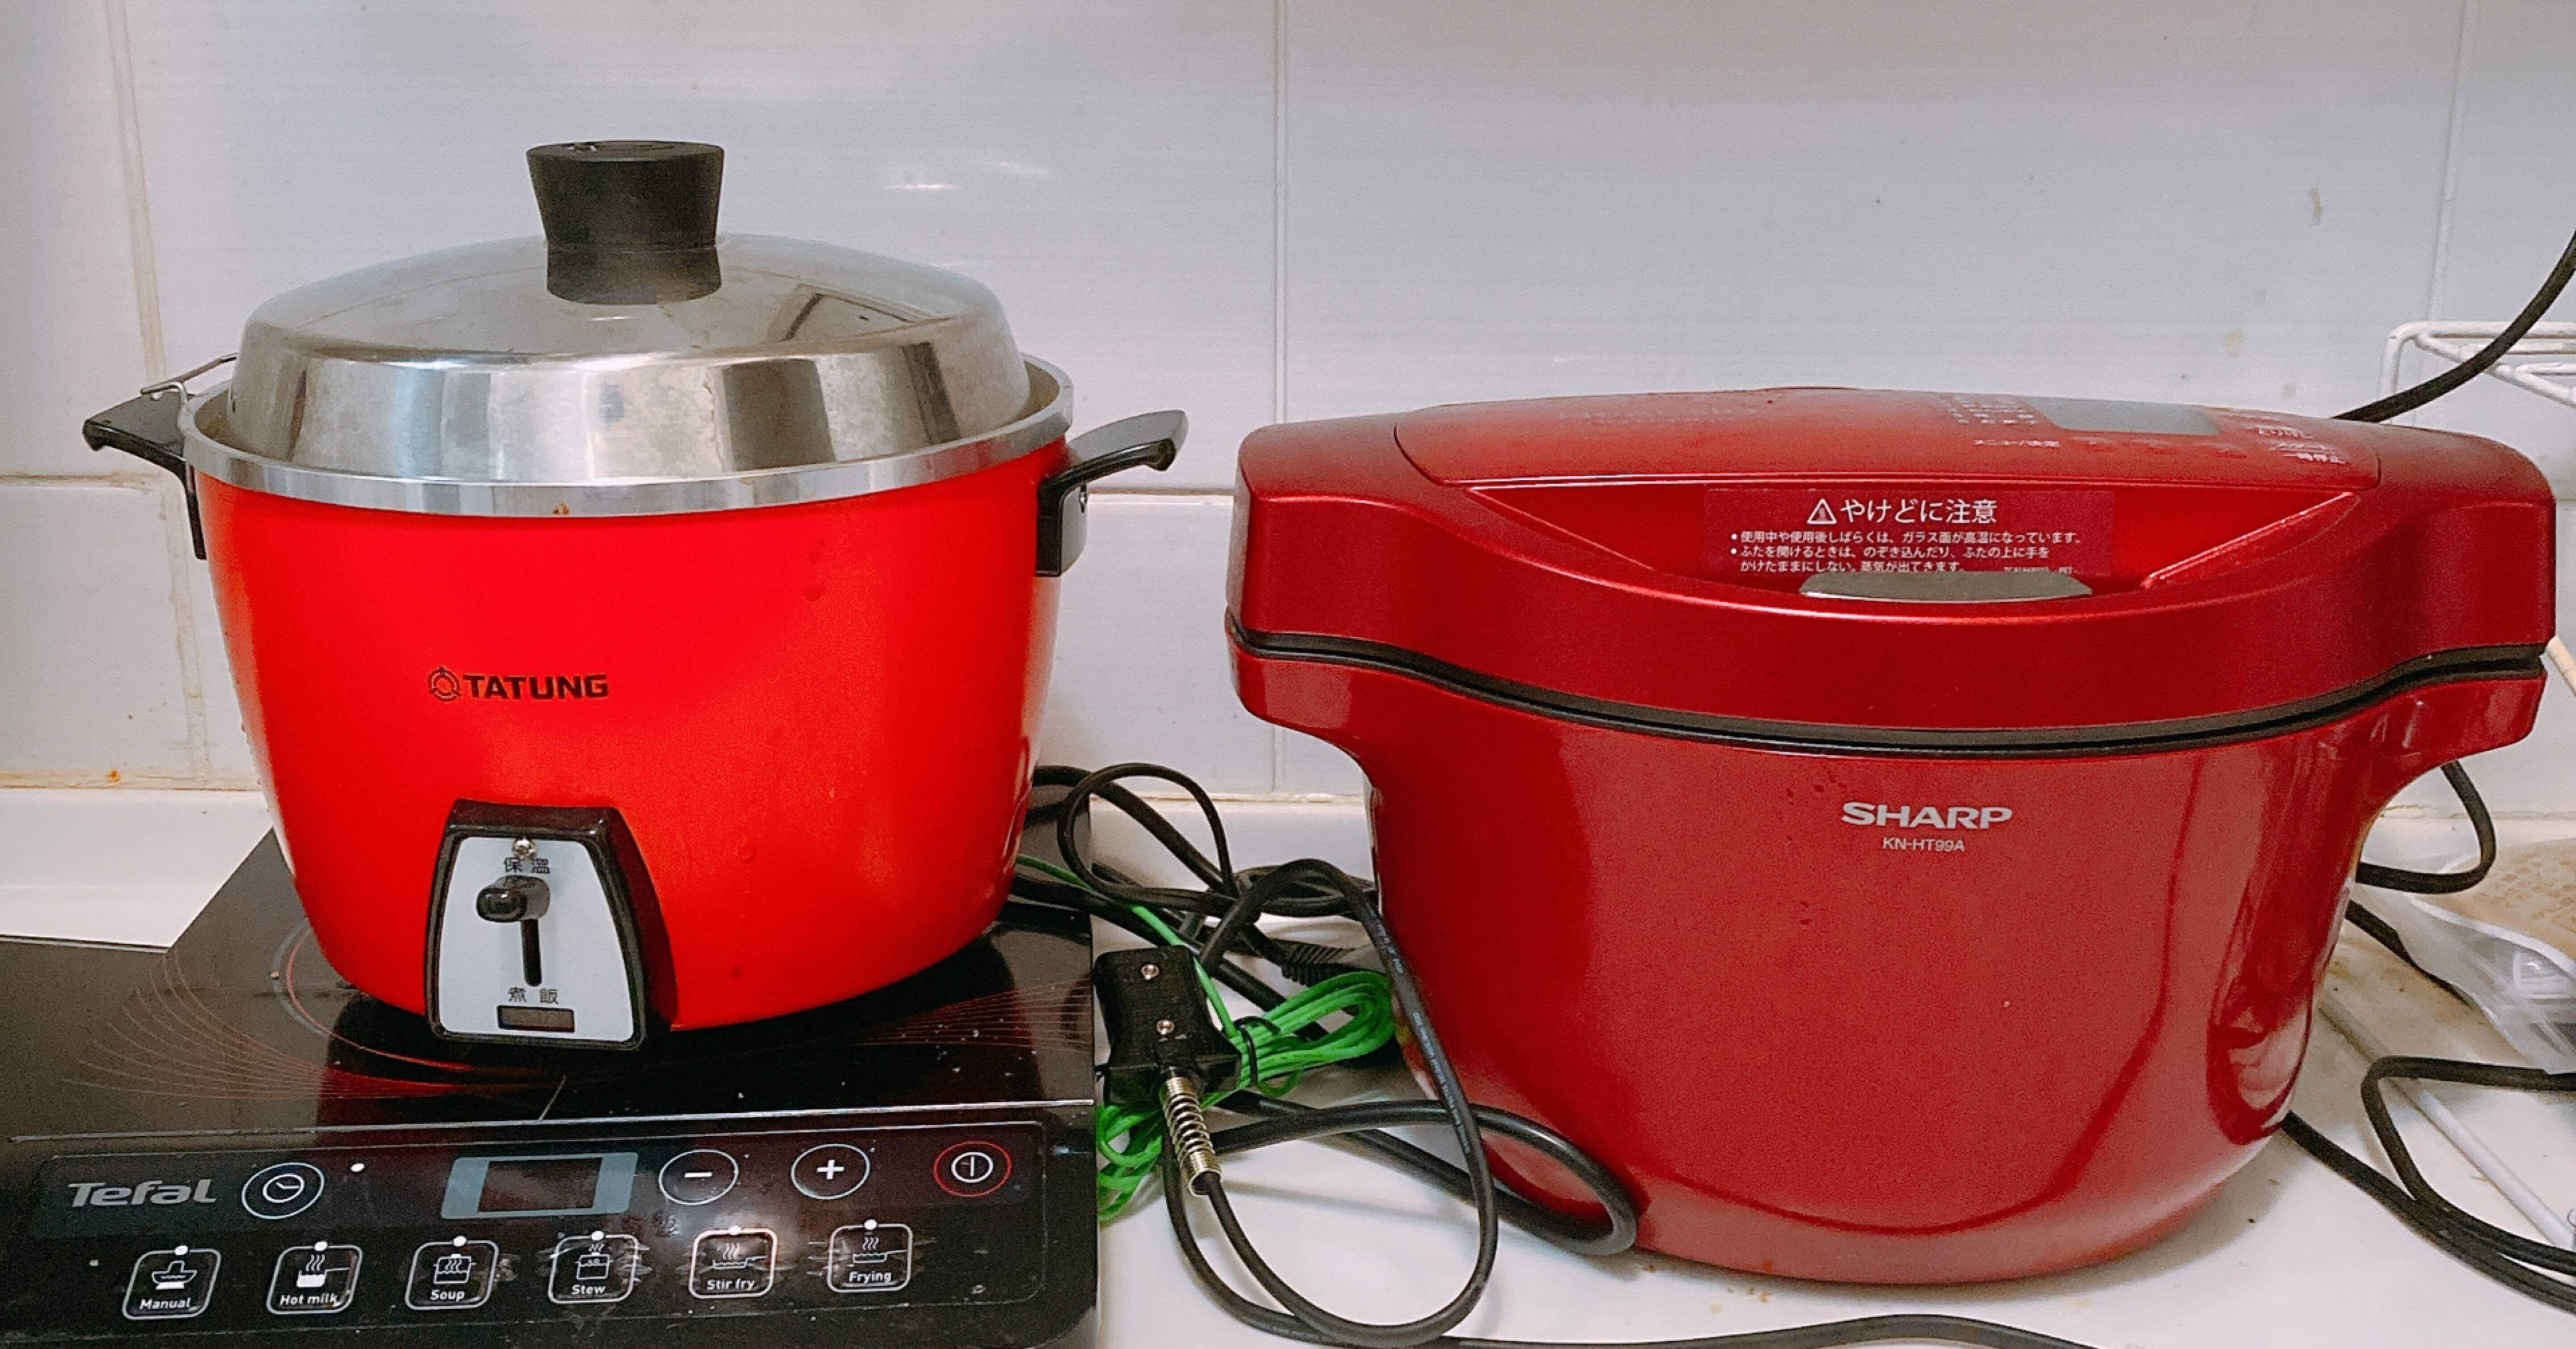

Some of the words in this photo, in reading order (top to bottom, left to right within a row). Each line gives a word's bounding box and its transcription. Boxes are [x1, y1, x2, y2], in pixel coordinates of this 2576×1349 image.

[1840, 499, 1997, 524] やけどに注意
[463, 674, 609, 699] TATUNG
[1841, 802, 2013, 829] SHARP
[1882, 836, 1965, 852] KN-HT99A
[508, 986, 559, 1005] 煮飯
[68, 1179, 217, 1207] Tefal
[707, 1279, 733, 1290] Stir
[735, 1277, 755, 1291] fry
[849, 1270, 891, 1284] Frying
[430, 1290, 465, 1302] Soup
[571, 1284, 606, 1295] Stew
[139, 1297, 191, 1310] Manual
[279, 1294, 304, 1305] Hot
[307, 1292, 339, 1305] milk
